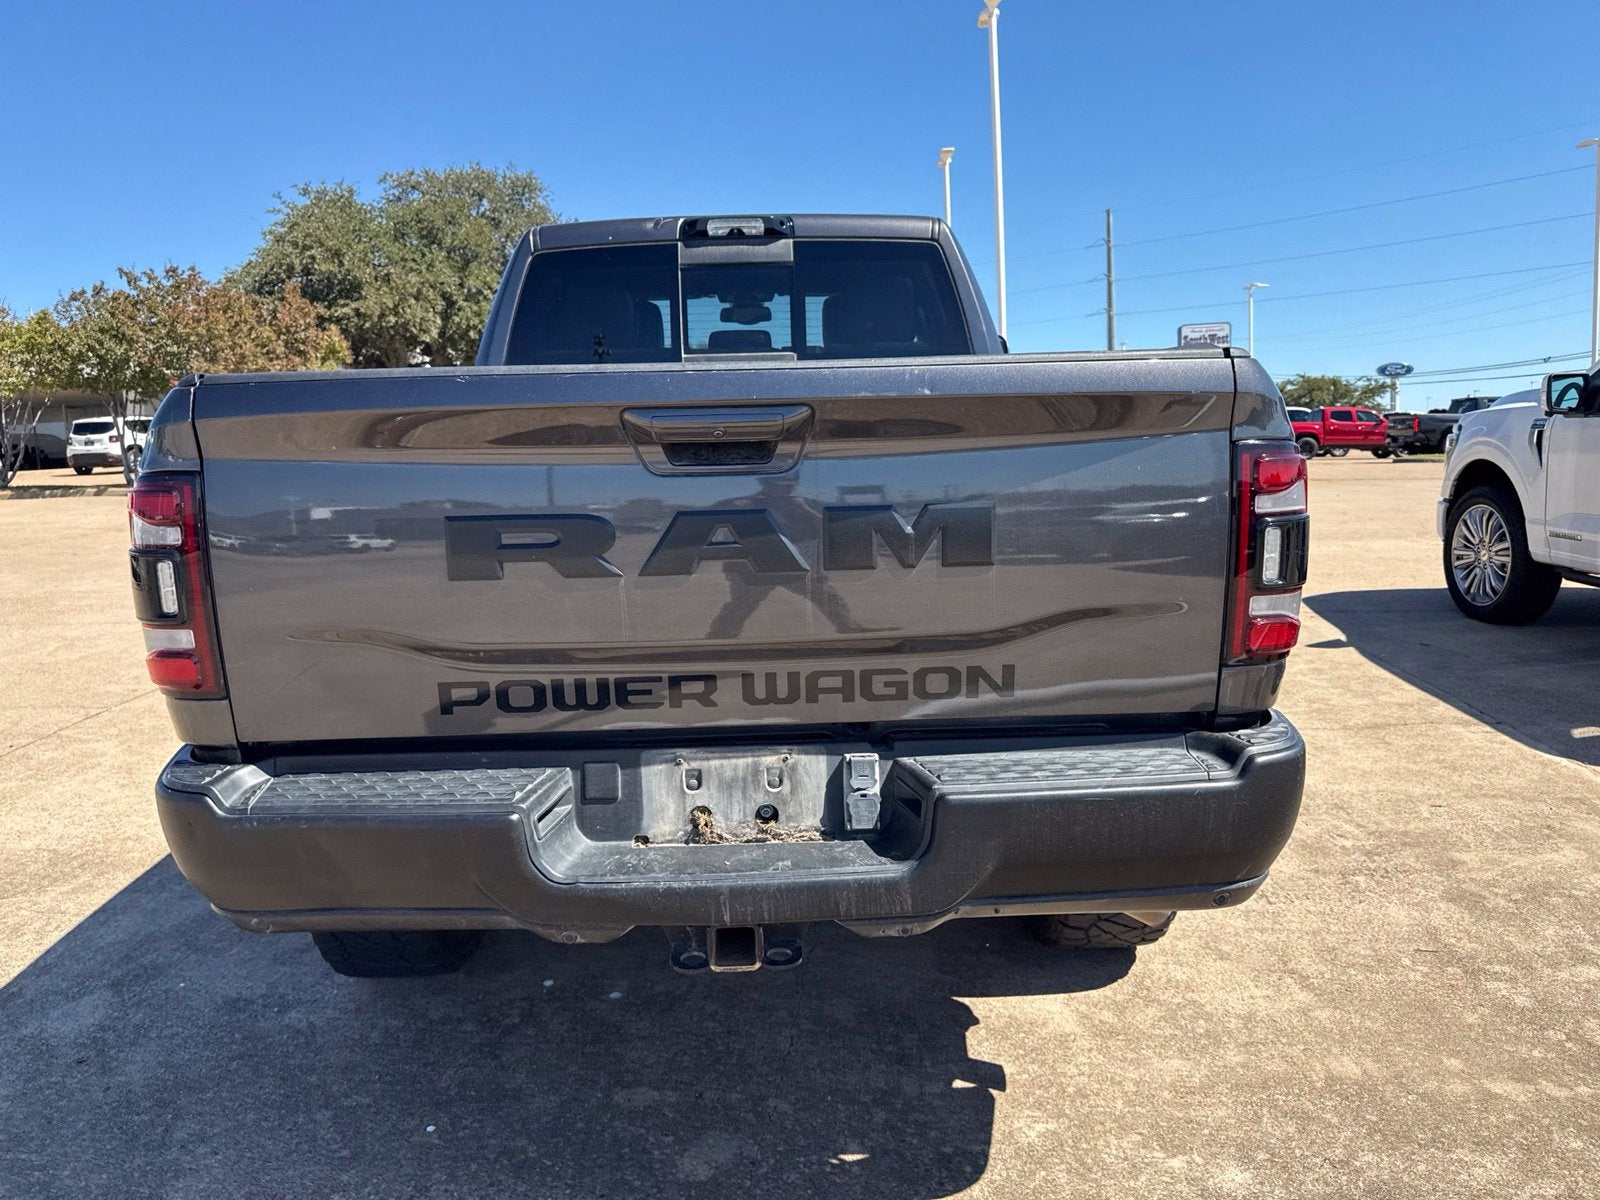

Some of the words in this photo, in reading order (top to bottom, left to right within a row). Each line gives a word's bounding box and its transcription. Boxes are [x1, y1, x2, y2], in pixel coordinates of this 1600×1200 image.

[1385, 365, 1407, 375] Ford
[444, 502, 996, 581] RAM
[437, 674, 718, 716] POWER
[741, 663, 1015, 707] WAGON
